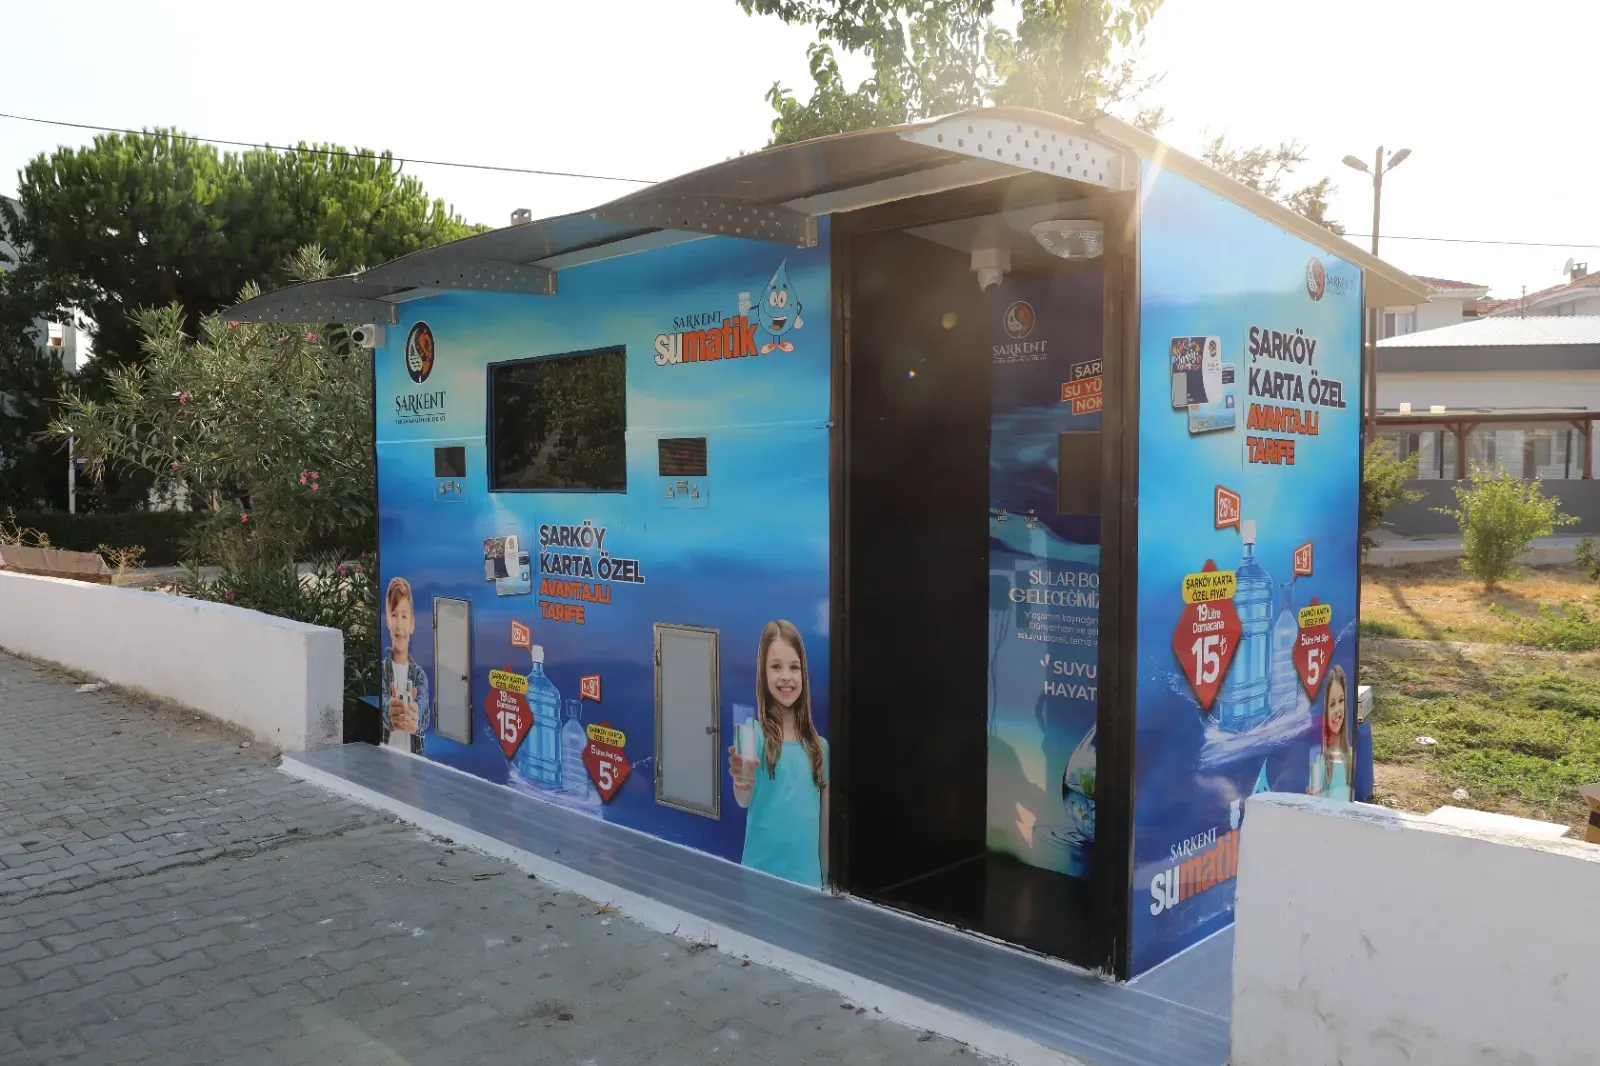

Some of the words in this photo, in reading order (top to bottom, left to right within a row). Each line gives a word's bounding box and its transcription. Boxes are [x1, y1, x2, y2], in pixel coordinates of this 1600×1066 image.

[672, 311, 724, 330] ŞARKENT
[654, 315, 759, 366] sumatik
[993, 341, 1047, 357] ŞARKENT
[1249, 325, 1316, 366] ŞARKÖY
[1065, 385, 1081, 398] SU
[1249, 367, 1305, 403] KARTA
[1308, 369, 1346, 408] ÖZEL
[395, 391, 446, 415] ŞARKENT
[1247, 403, 1319, 435] AVANTAJLI
[1247, 436, 1295, 465] TARİFE
[539, 520, 607, 550] ŞARKÖY
[540, 551, 594, 578] KARTA
[598, 551, 645, 584] ÖZEL
[1029, 569, 1075, 587] SULAR
[1078, 571, 1099, 589] BO
[1186, 577, 1211, 590] ŞARKÖY
[1212, 574, 1233, 586] KARTA
[539, 578, 611, 604] AVANTAJLI
[1192, 589, 1209, 602] ÖZEL
[1210, 587, 1227, 599] FİYAT
[539, 601, 585, 625] TARİFE
[1197, 604, 1208, 621] 19
[1193, 620, 1224, 634] Damacana
[1053, 660, 1097, 679] SUYU
[500, 691, 507, 702] 19
[1044, 681, 1097, 701] HAYAT
[1170, 827, 1218, 863] ŞARKENT
